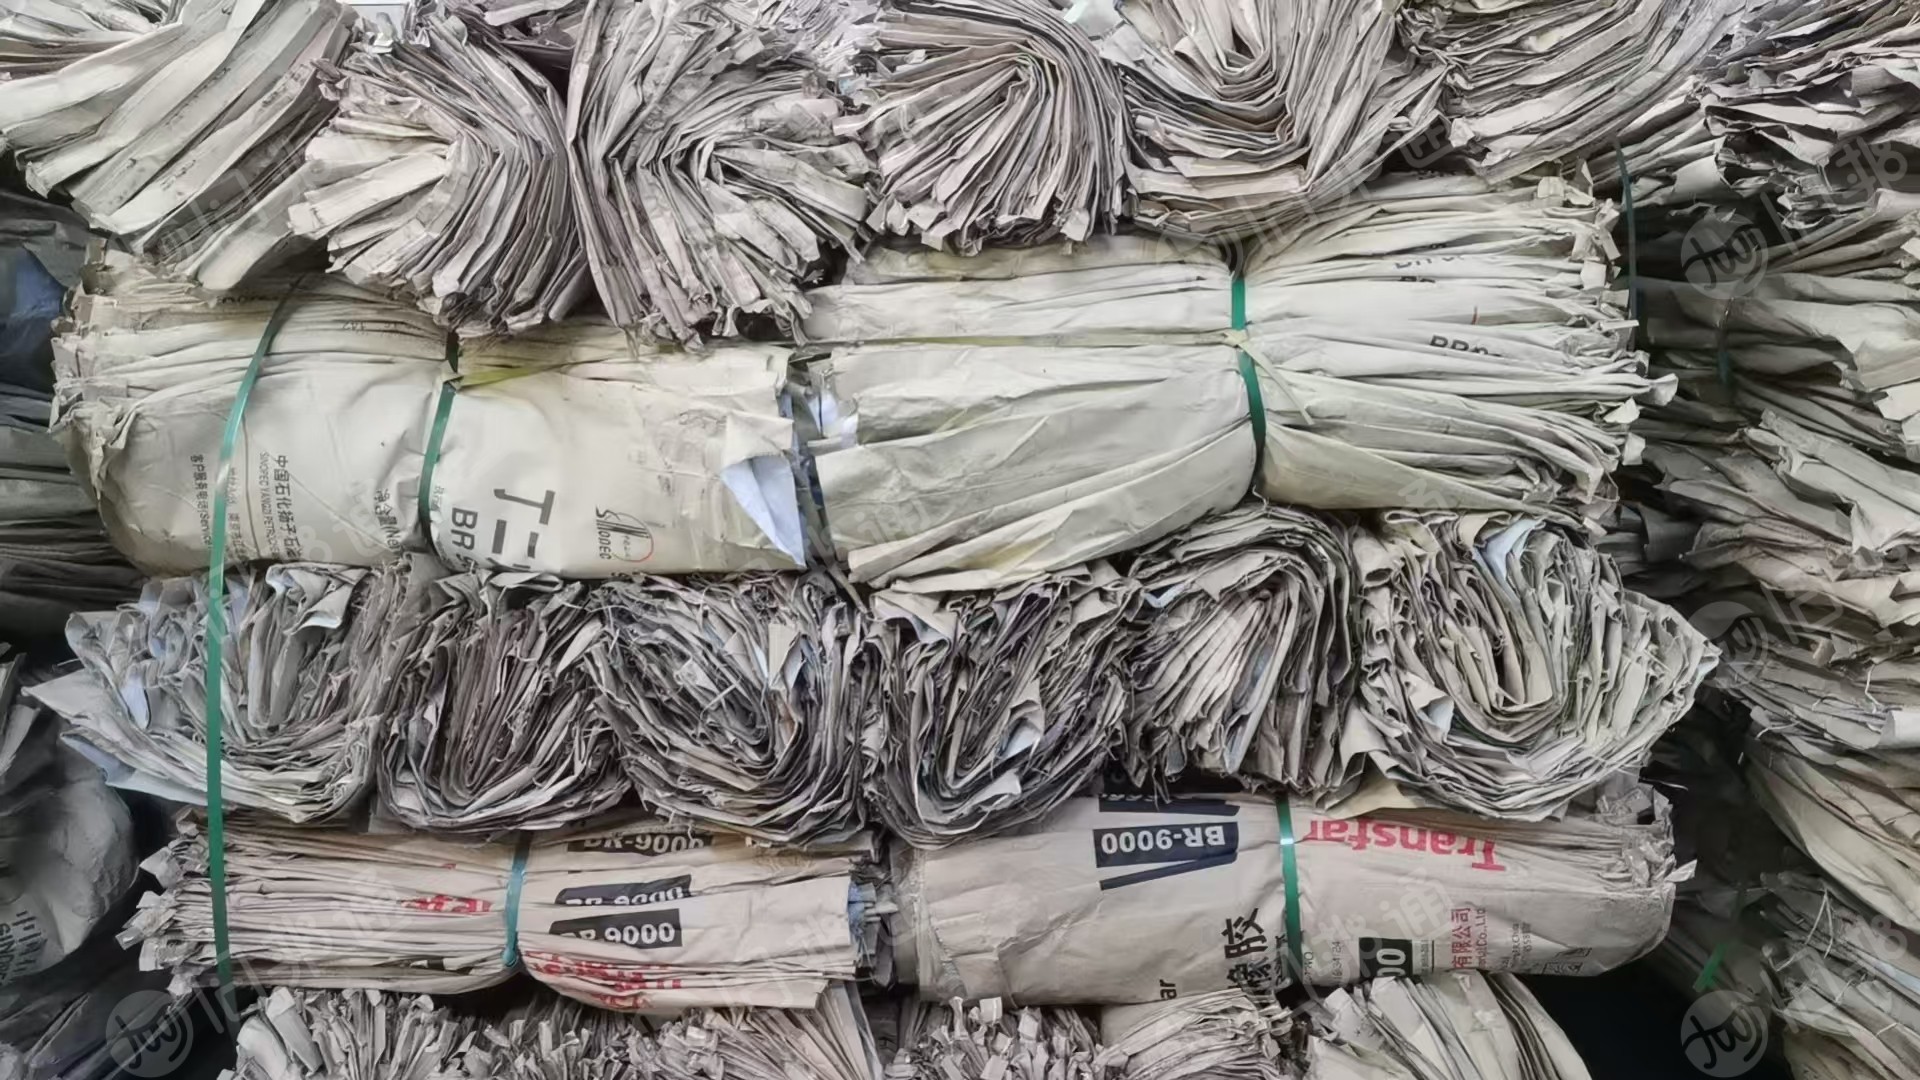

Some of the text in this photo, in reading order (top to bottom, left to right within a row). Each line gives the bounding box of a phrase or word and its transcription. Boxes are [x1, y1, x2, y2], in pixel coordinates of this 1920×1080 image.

[1101, 825, 1226, 855] BR-9000
[1302, 817, 1506, 871] Transfar
[1451, 907, 1472, 969] 有限公司
